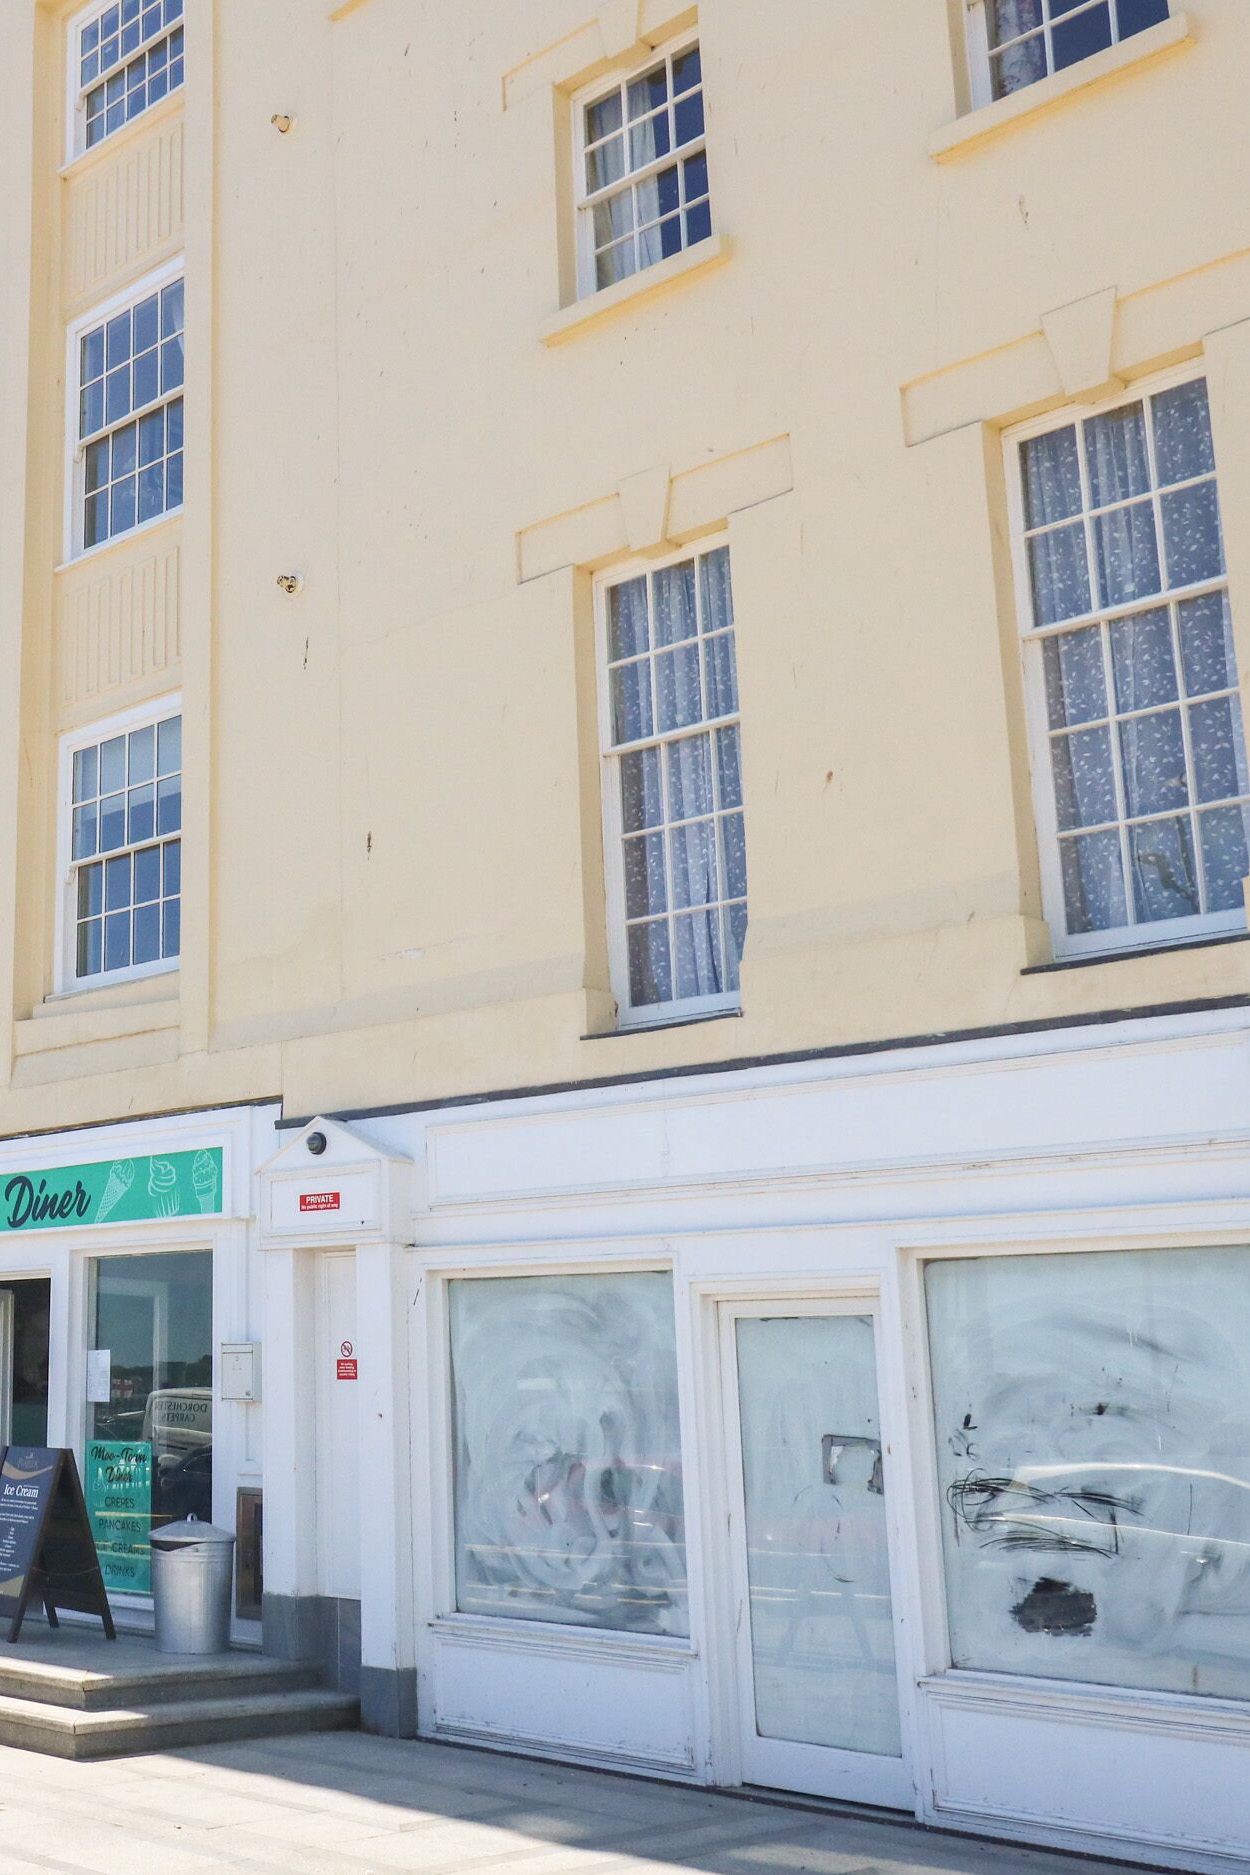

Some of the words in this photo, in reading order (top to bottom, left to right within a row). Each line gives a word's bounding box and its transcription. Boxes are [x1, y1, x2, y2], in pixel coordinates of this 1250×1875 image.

[5, 1175, 92, 1228] Diner
[306, 1195, 334, 1204] PRIVATE
[3, 1483, 15, 1496] Ice
[15, 1485, 39, 1498] Cream
[105, 1496, 135, 1508] CREPES
[99, 1519, 141, 1533] PANCAKES
[105, 1564, 136, 1578] DRINKS
